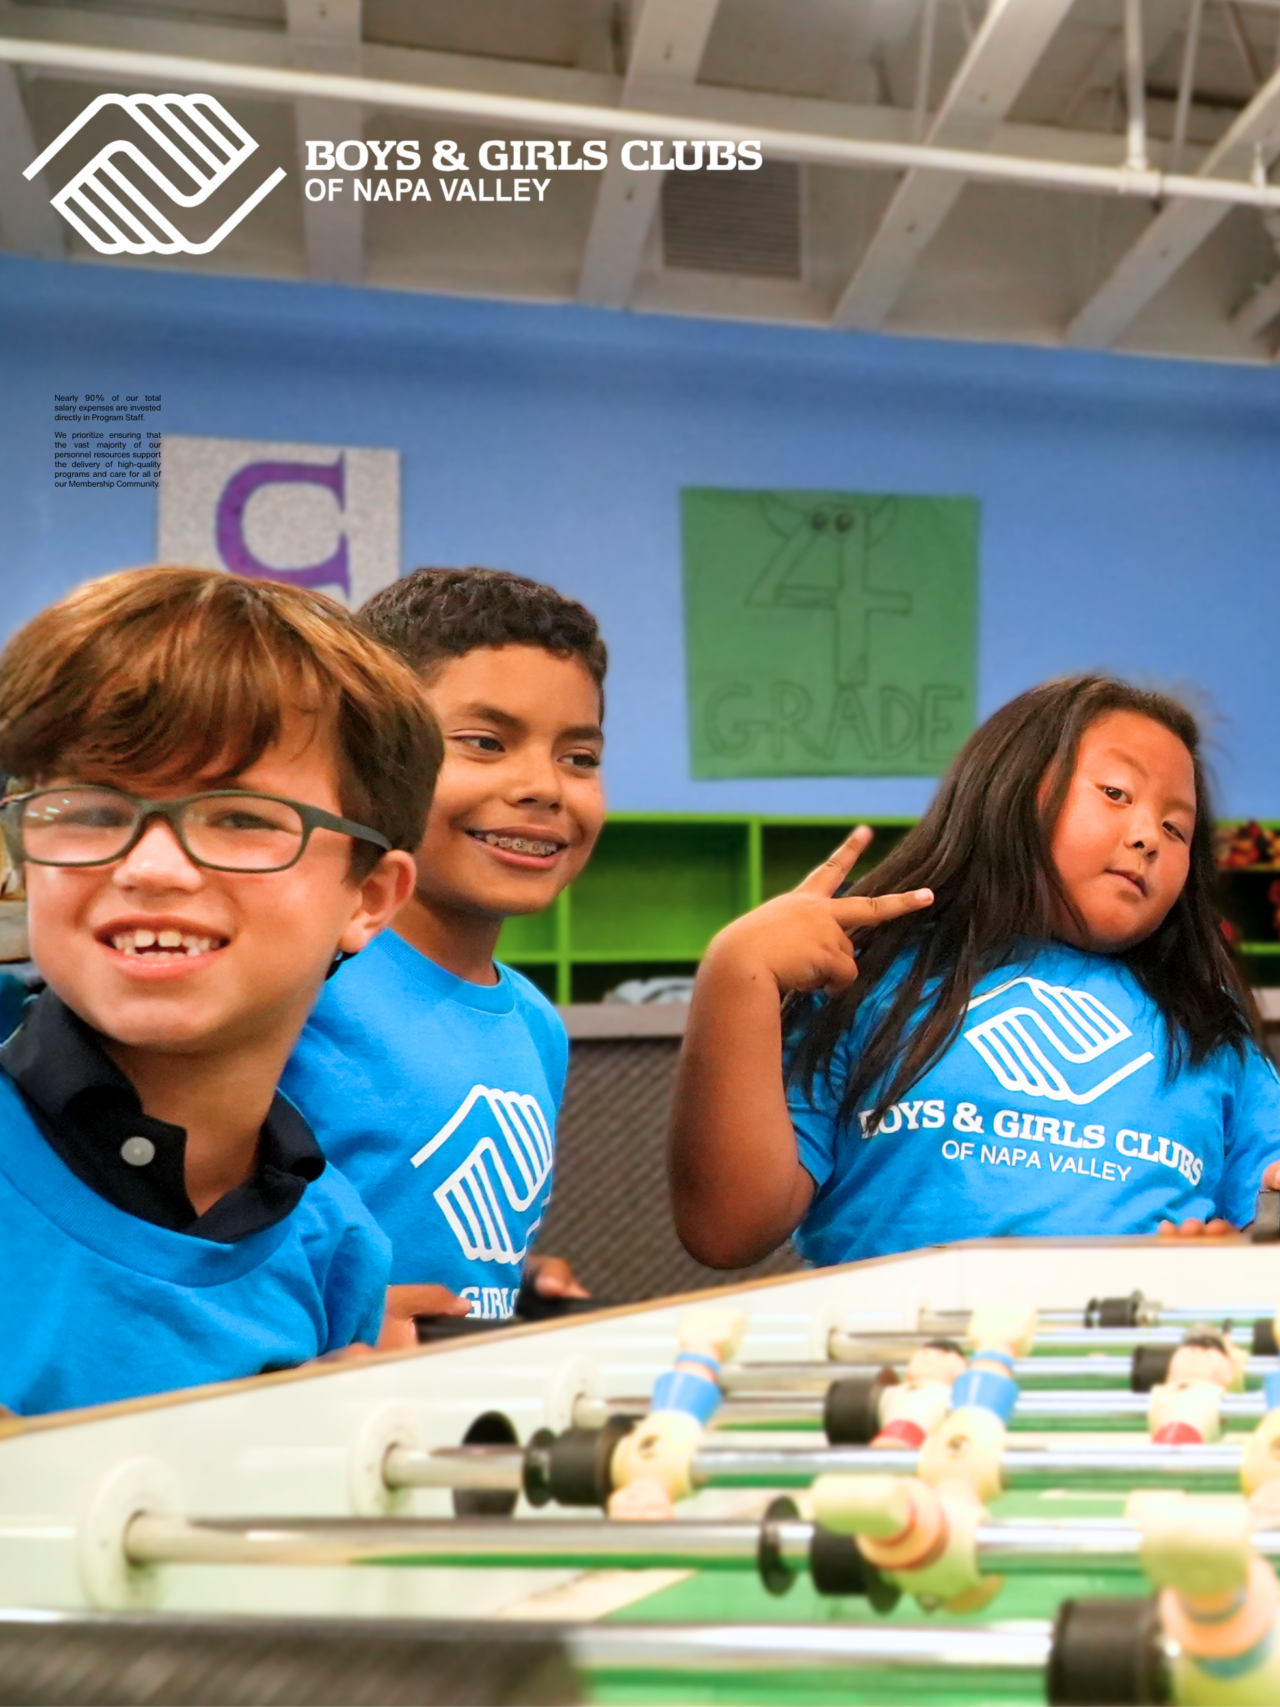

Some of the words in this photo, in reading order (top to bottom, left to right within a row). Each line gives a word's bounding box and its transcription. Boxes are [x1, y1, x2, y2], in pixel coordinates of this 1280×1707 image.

[744, 502, 913, 687] 4
[703, 680, 964, 762] GRADE
[942, 1140, 975, 1160] OF
[980, 1144, 1042, 1169] NAPA
[1049, 1152, 1132, 1182] VALLEY
[952, 1101, 984, 1134] &
[993, 1109, 1105, 1149] GIRLS
[1115, 1129, 1204, 1187] CLUBS
